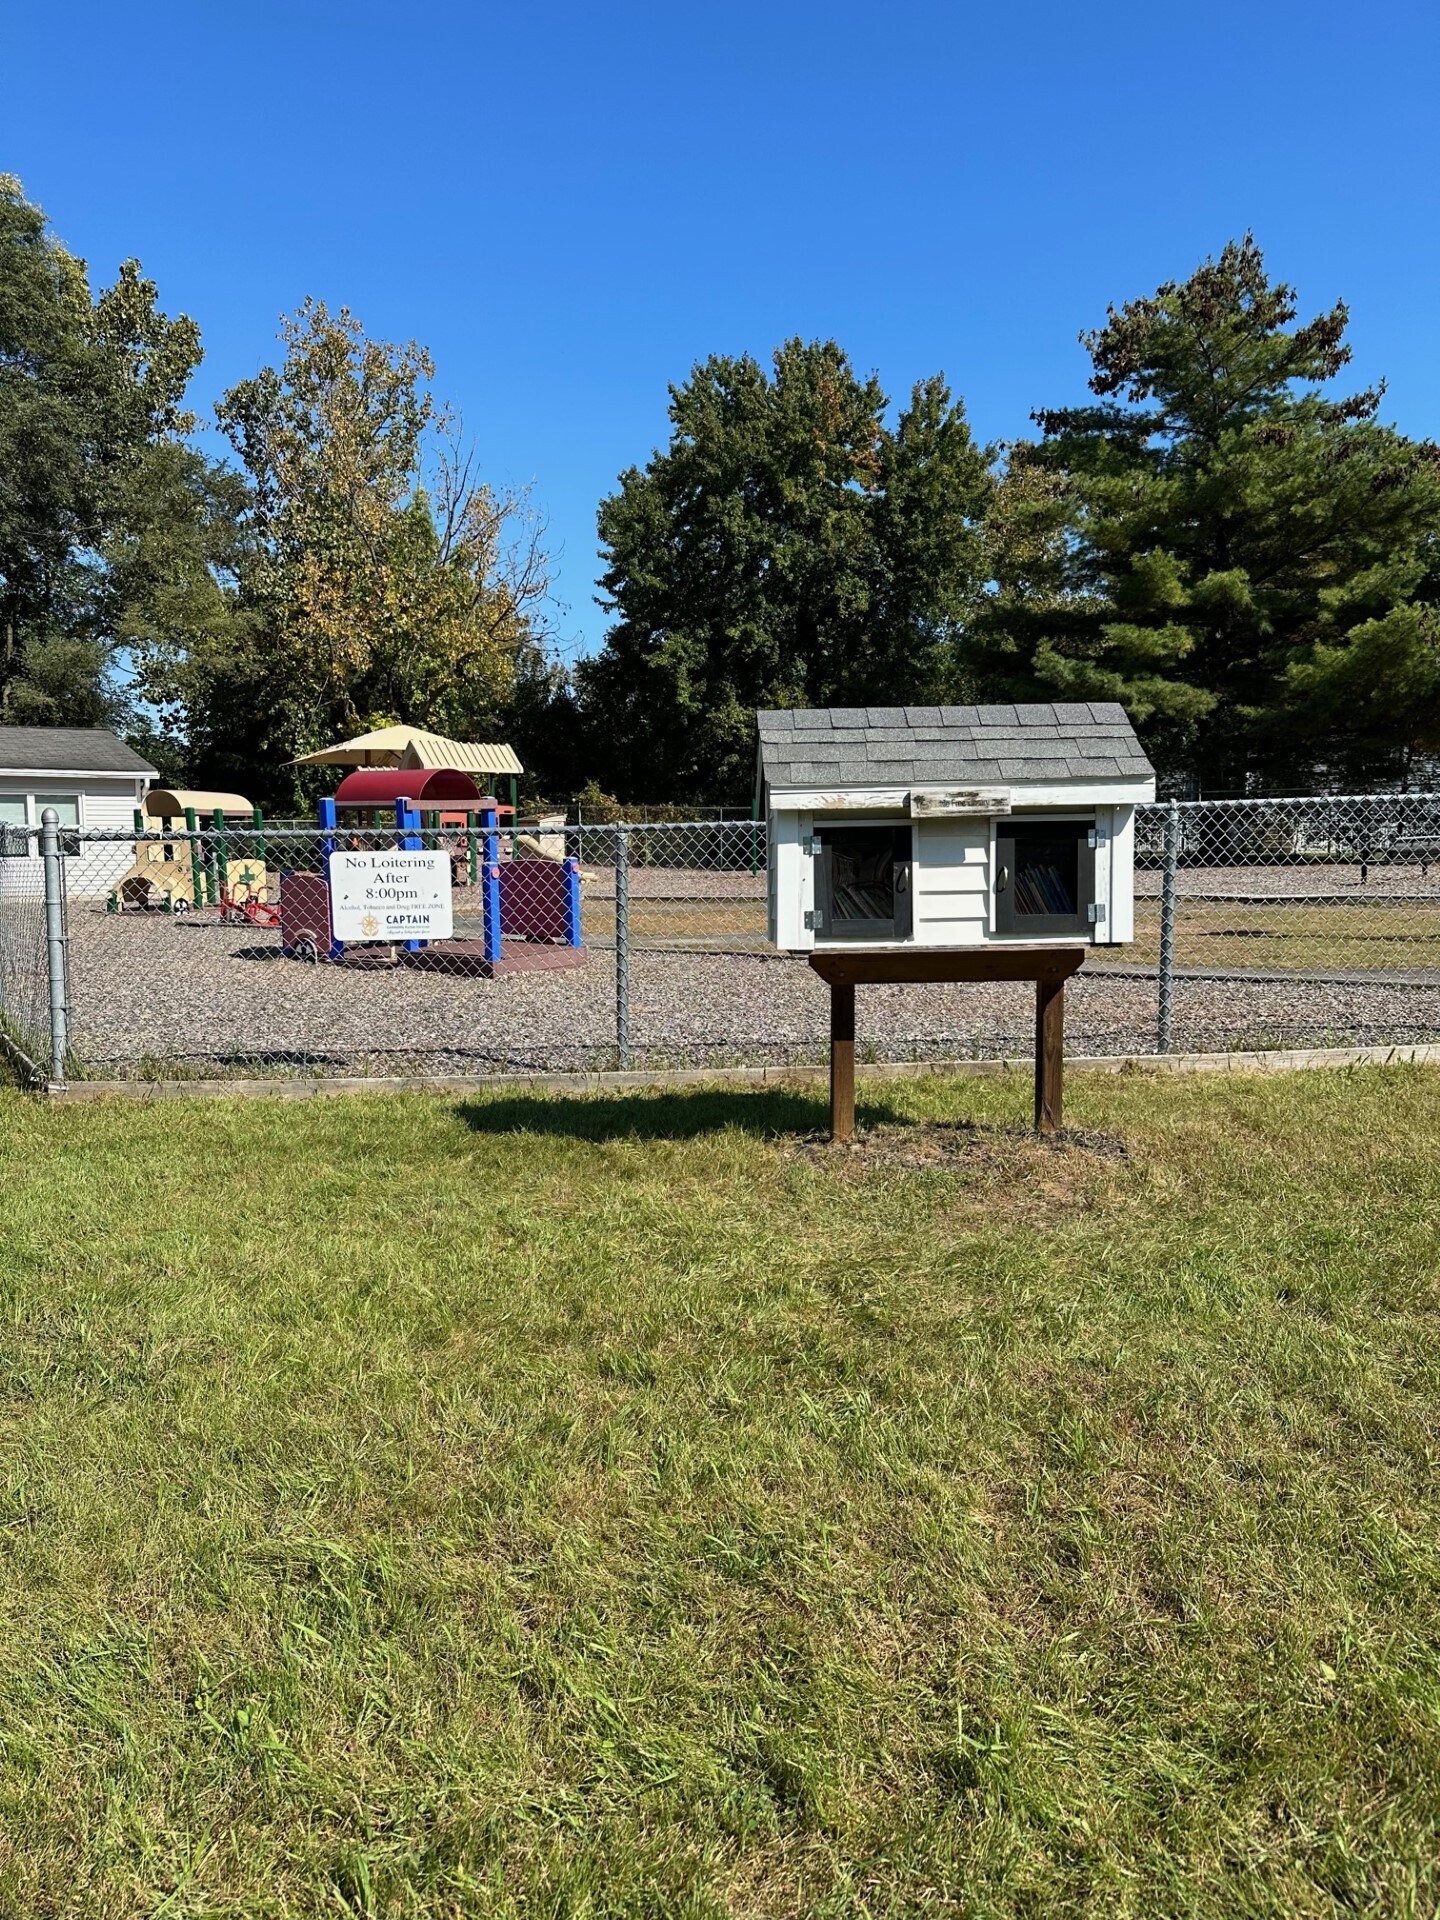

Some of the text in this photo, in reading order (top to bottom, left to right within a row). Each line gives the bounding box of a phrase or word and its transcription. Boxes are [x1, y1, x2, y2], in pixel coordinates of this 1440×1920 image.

[346, 857, 435, 870] No Loitering
[373, 873, 410, 884] After
[365, 888, 418, 901] 8:00pm
[386, 915, 430, 924] CAPTAIN
